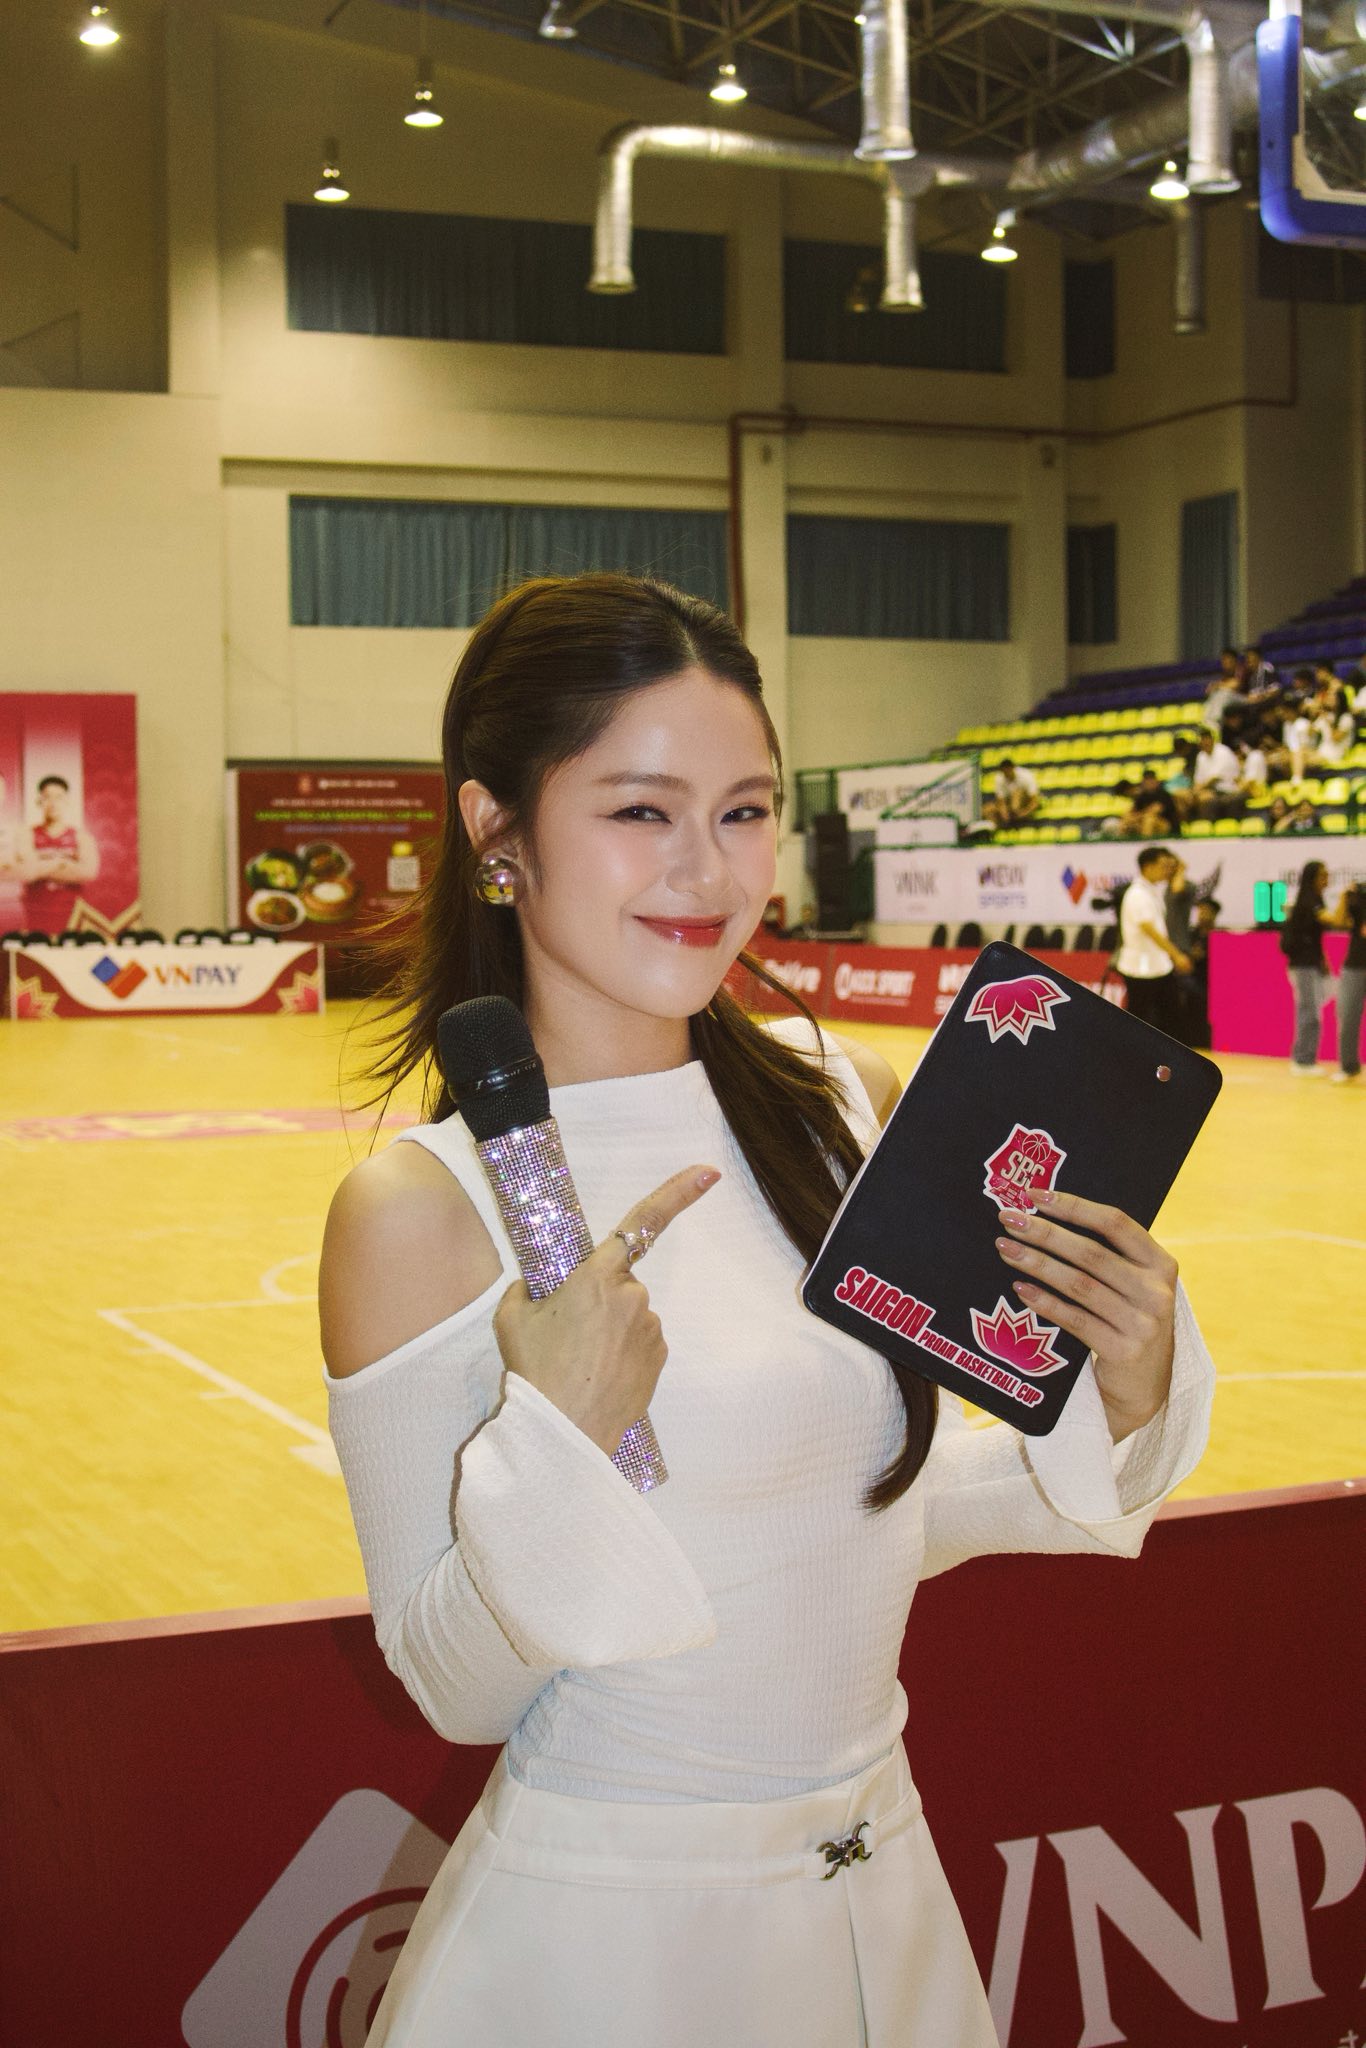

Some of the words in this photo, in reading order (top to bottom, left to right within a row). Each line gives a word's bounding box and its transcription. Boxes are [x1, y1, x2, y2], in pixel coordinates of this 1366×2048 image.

[155, 964, 242, 985] VNPAY
[1001, 1150, 1046, 1191] SBC
[836, 1267, 935, 1339] SAIGON
[917, 1330, 959, 1361] PROAM
[955, 1351, 1019, 1394] BASKETBALL
[1016, 1384, 1042, 1405] CUP
